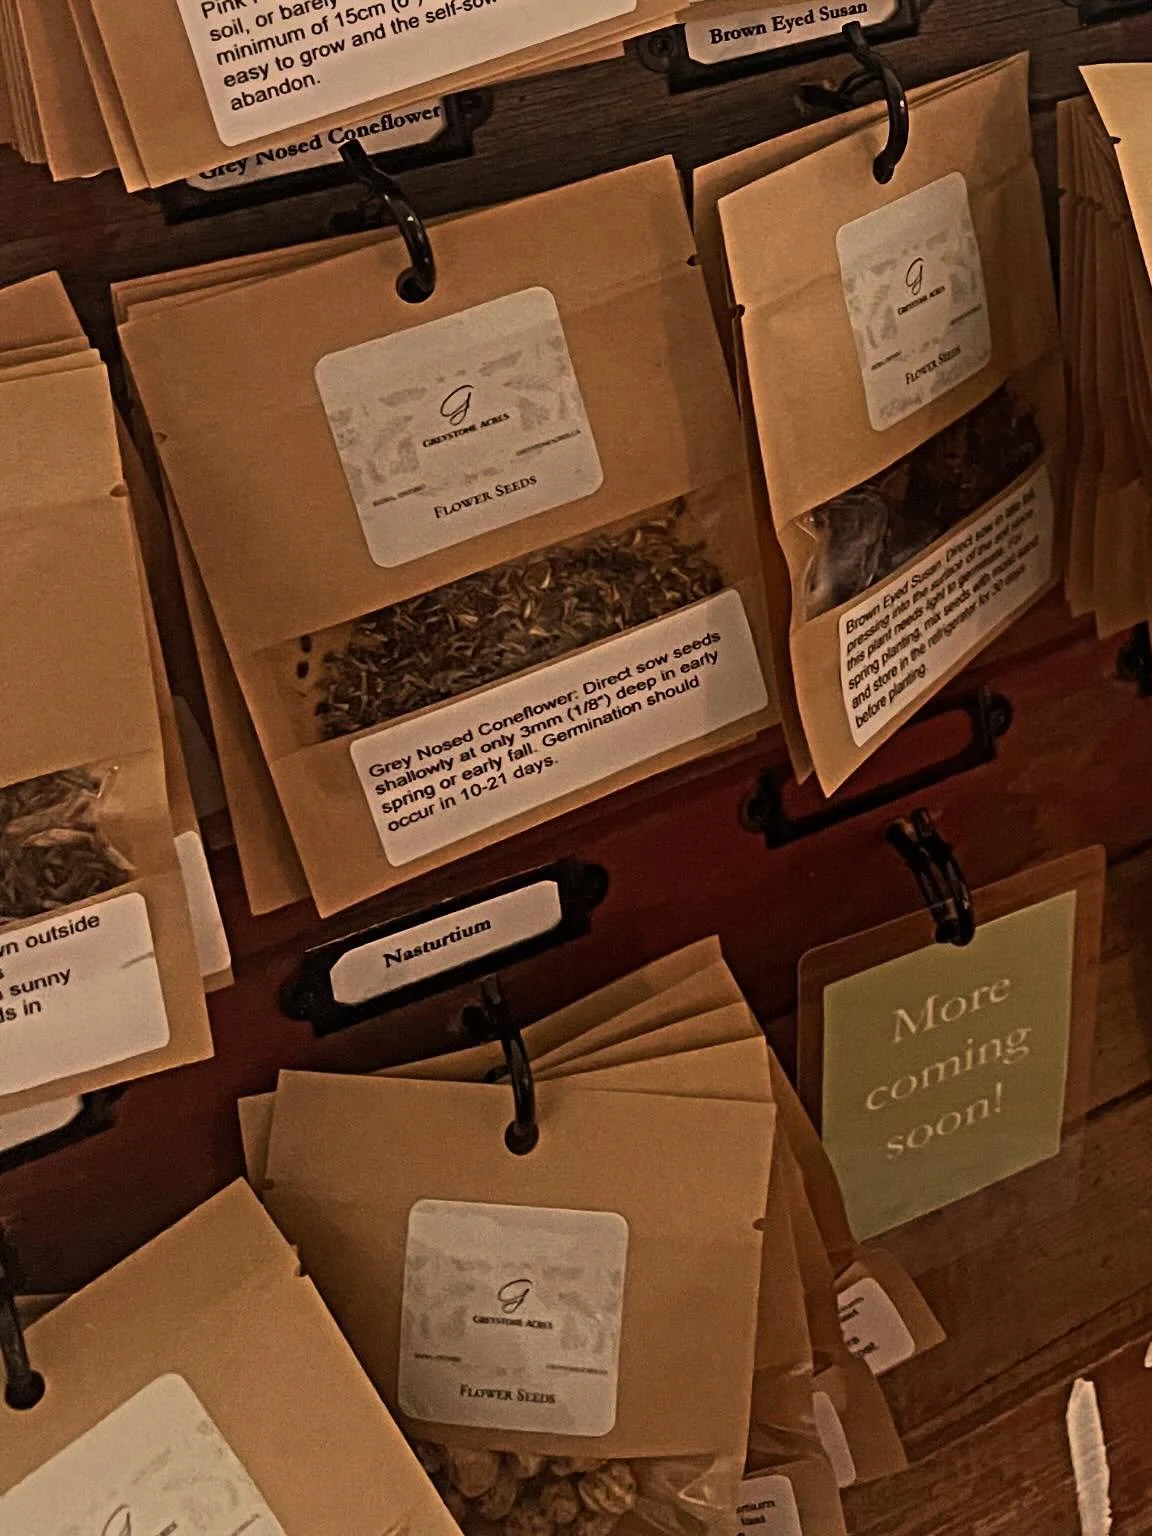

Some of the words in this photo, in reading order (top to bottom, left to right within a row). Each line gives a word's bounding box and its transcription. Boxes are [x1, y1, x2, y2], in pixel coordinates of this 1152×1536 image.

[209, 16, 250, 42] soil,
[254, 10, 274, 27] or
[215, 27, 306, 65] minimum
[310, 14, 329, 35] of
[333, 2, 386, 27] 15cm
[223, 62, 269, 87] easy
[274, 55, 294, 71] to
[299, 38, 345, 67] grow
[350, 22, 386, 47] and
[389, 15, 420, 34] the
[709, 22, 767, 45] Brown
[771, 9, 816, 34] Eyed
[819, 2, 868, 21] Susan
[230, 73, 320, 111] abandon.
[255, 135, 322, 165] Nosed
[328, 105, 442, 145] Coneflower
[368, 754, 411, 777] Grey
[415, 728, 474, 761] Nosed
[477, 689, 578, 736] Coneflower:
[582, 665, 632, 695] Direct
[635, 652, 668, 674] sow
[672, 632, 721, 659] seeds
[374, 756, 454, 795] shallowly
[459, 746, 477, 762] at
[479, 732, 515, 760] only
[519, 714, 563, 738] 3mm
[615, 676, 657, 699] deep
[659, 668, 676, 681] in
[679, 649, 718, 674] early
[381, 784, 436, 814] spring
[438, 774, 457, 789] or
[460, 755, 502, 780] early
[506, 741, 538, 762] fall.
[541, 700, 642, 747] Germination
[645, 674, 700, 706] should
[387, 803, 435, 832] occur
[438, 796, 456, 810] in
[459, 771, 507, 800] 10-21
[512, 755, 558, 779] days.
[25, 914, 101, 949] outside
[382, 919, 492, 968] Nasturtium
[9, 968, 72, 997] sunny
[23, 999, 42, 1017] in
[891, 977, 1012, 1043] More
[865, 1027, 1033, 1111] coming
[886, 1081, 1002, 1159] soon!
